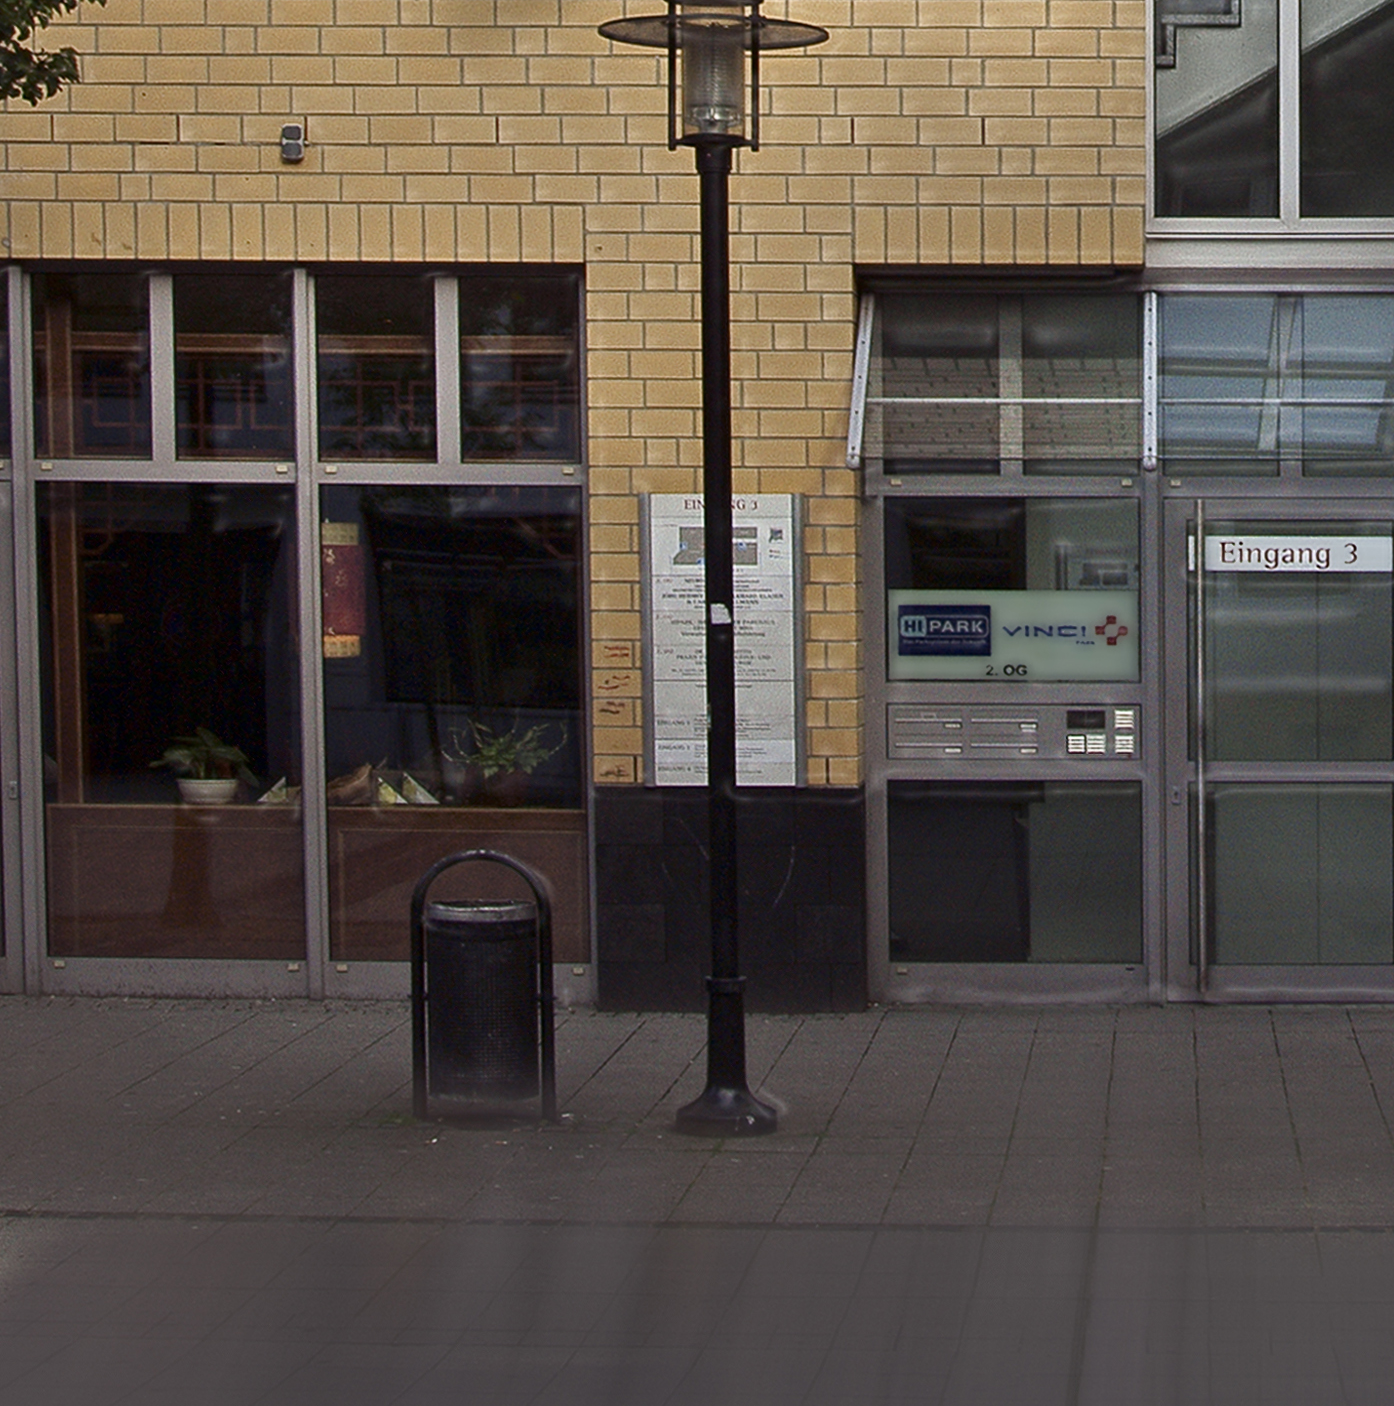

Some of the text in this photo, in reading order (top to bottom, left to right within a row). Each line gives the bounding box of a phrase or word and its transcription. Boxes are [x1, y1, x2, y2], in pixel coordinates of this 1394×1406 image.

[1220, 541, 1358, 570] Eingang 3
[986, 664, 1028, 677] 2. OG
